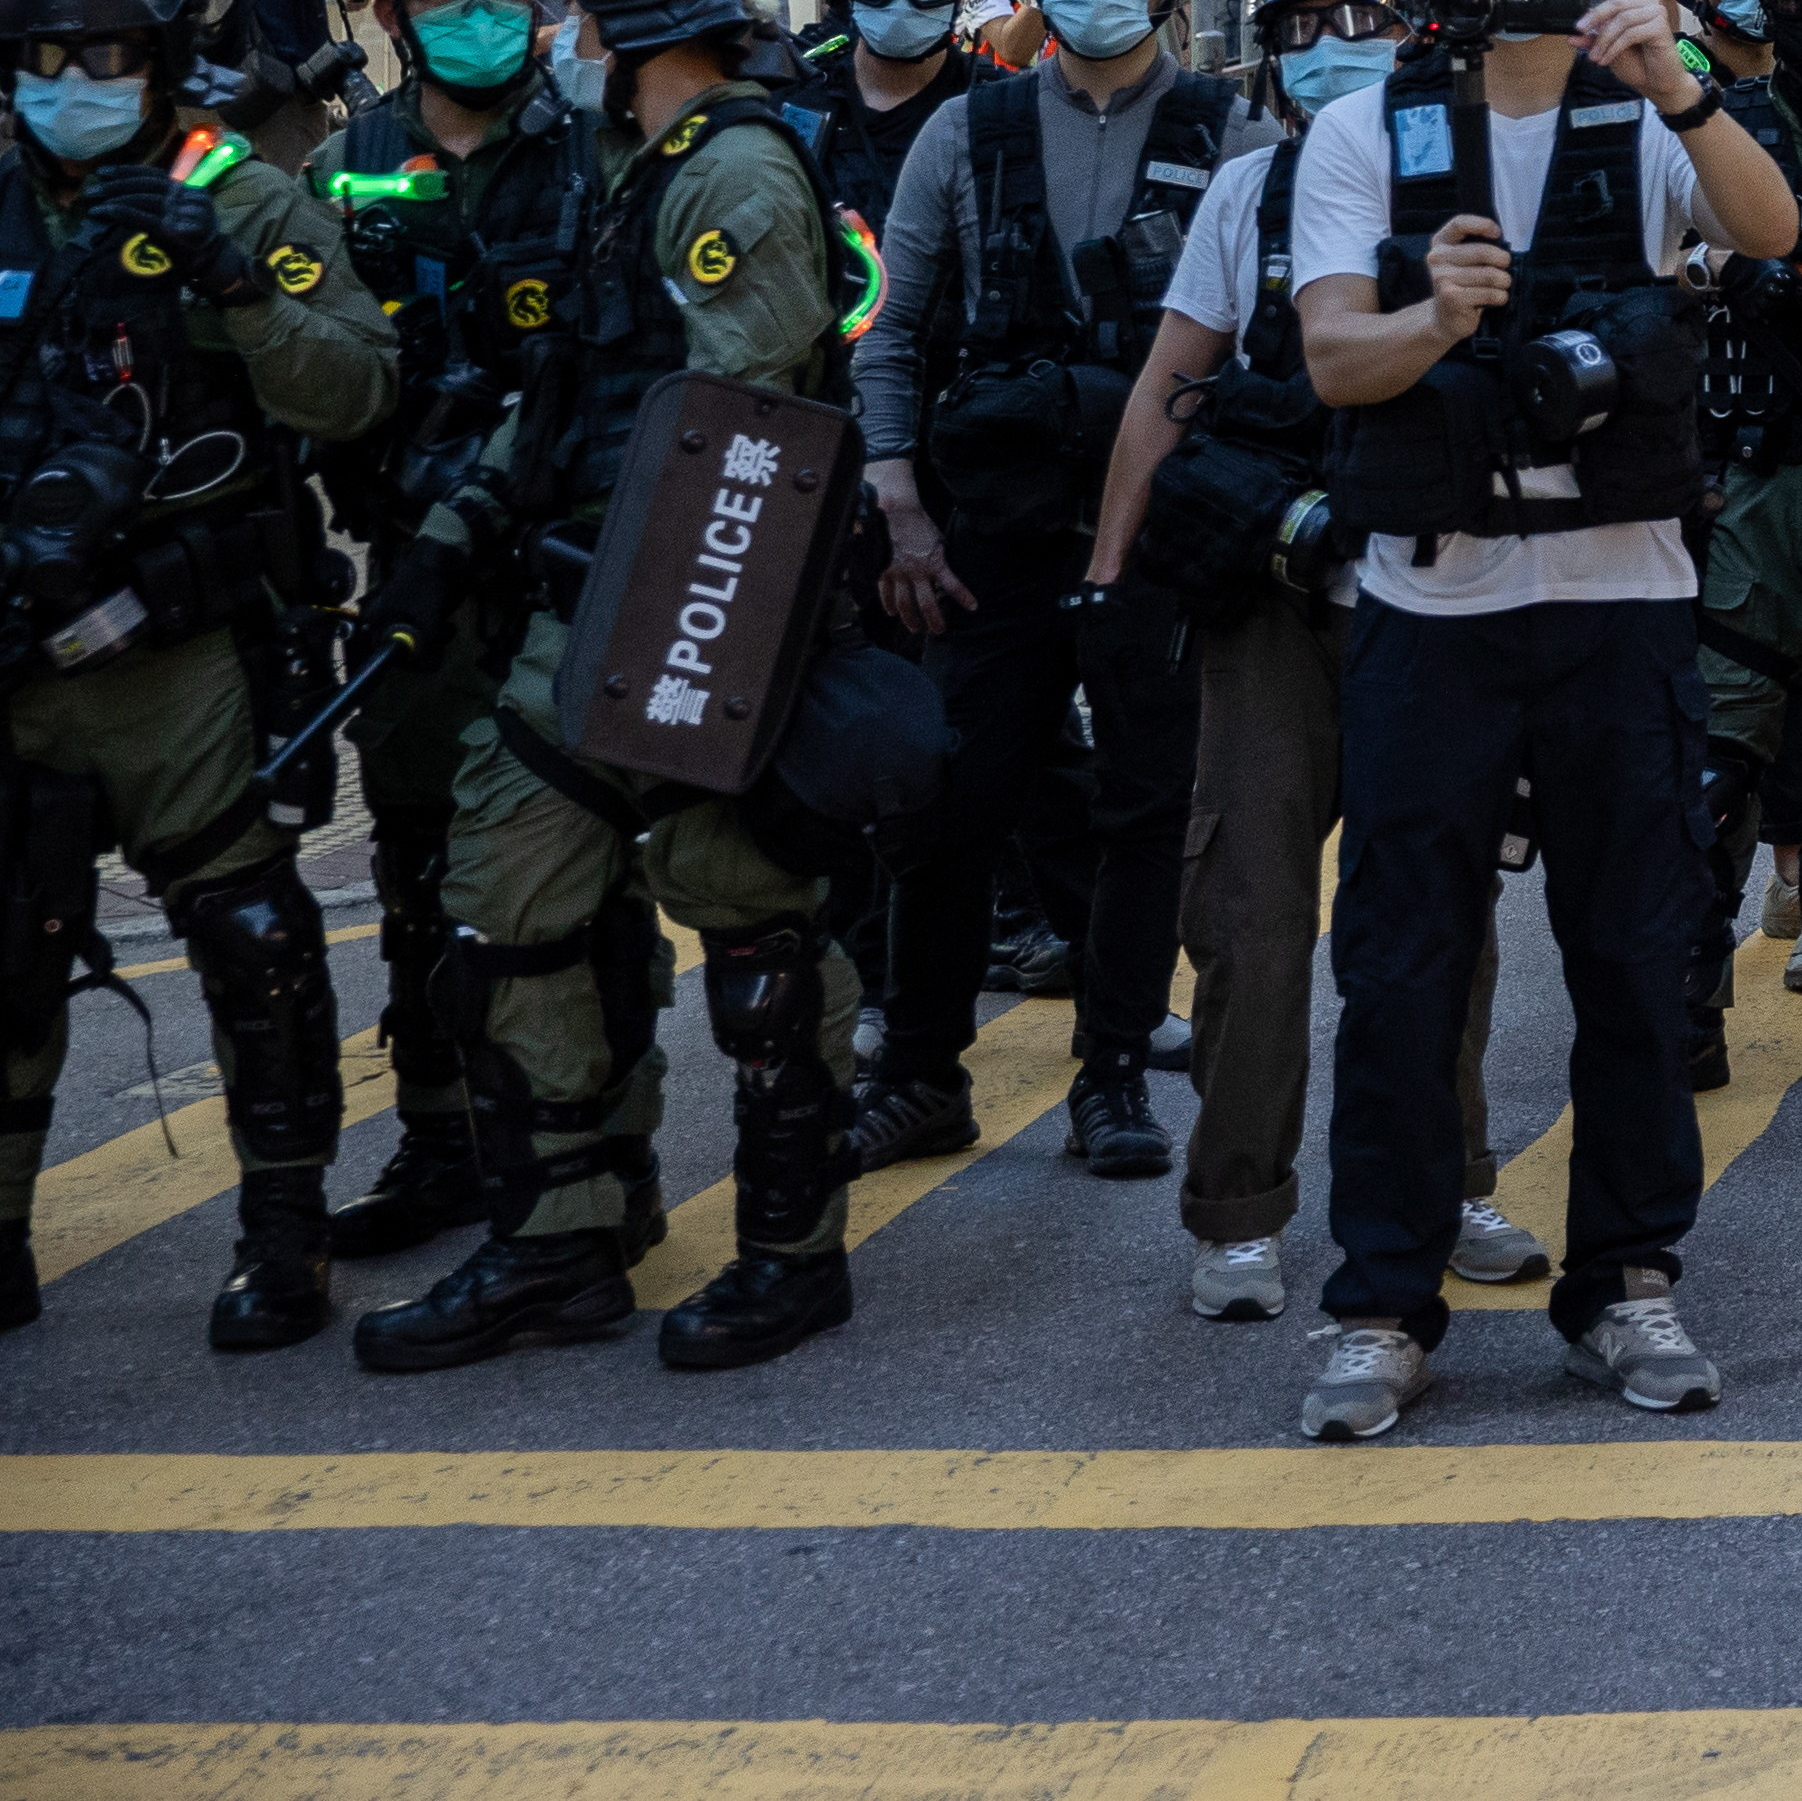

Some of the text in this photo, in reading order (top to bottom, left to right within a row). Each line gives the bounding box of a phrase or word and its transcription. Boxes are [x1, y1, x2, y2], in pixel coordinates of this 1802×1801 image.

[1577, 103, 1640, 124] POLICE
[1153, 164, 1206, 184] POLICE
[666, 487, 763, 675] POLICE
